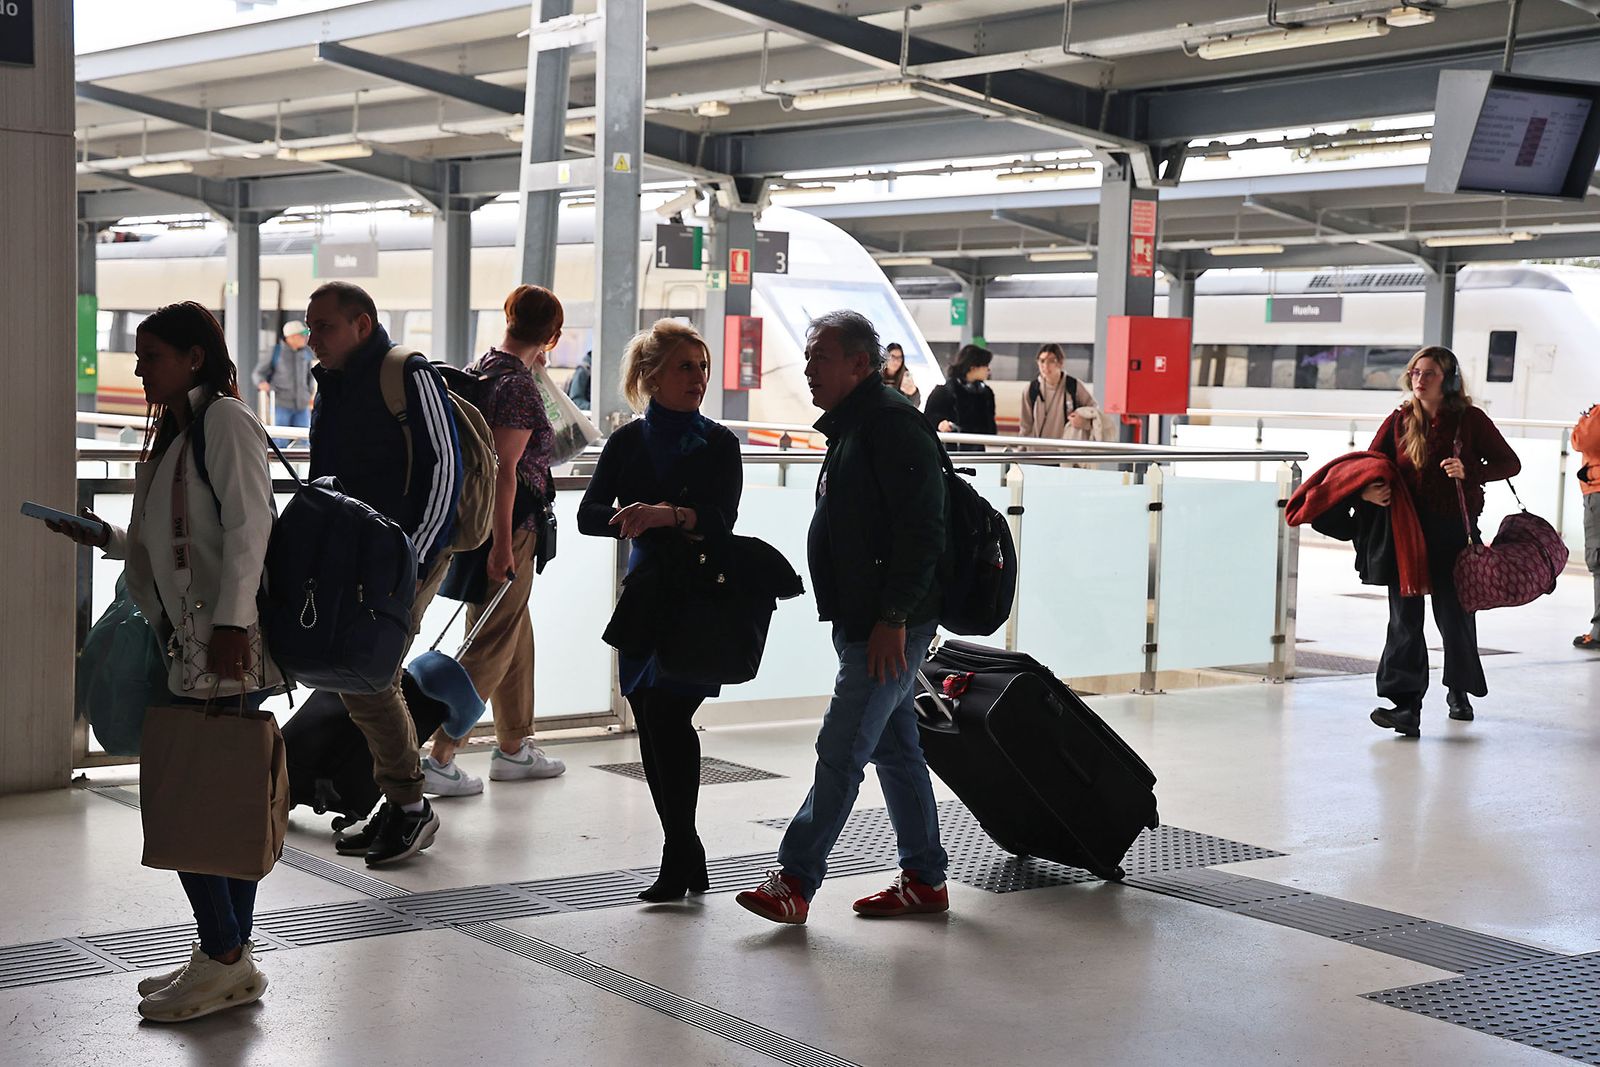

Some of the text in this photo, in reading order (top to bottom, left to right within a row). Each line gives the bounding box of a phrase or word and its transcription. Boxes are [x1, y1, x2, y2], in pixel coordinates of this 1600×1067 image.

[657, 245, 670, 268] 1
[775, 251, 787, 274] 3
[176, 547, 186, 569] BAG
